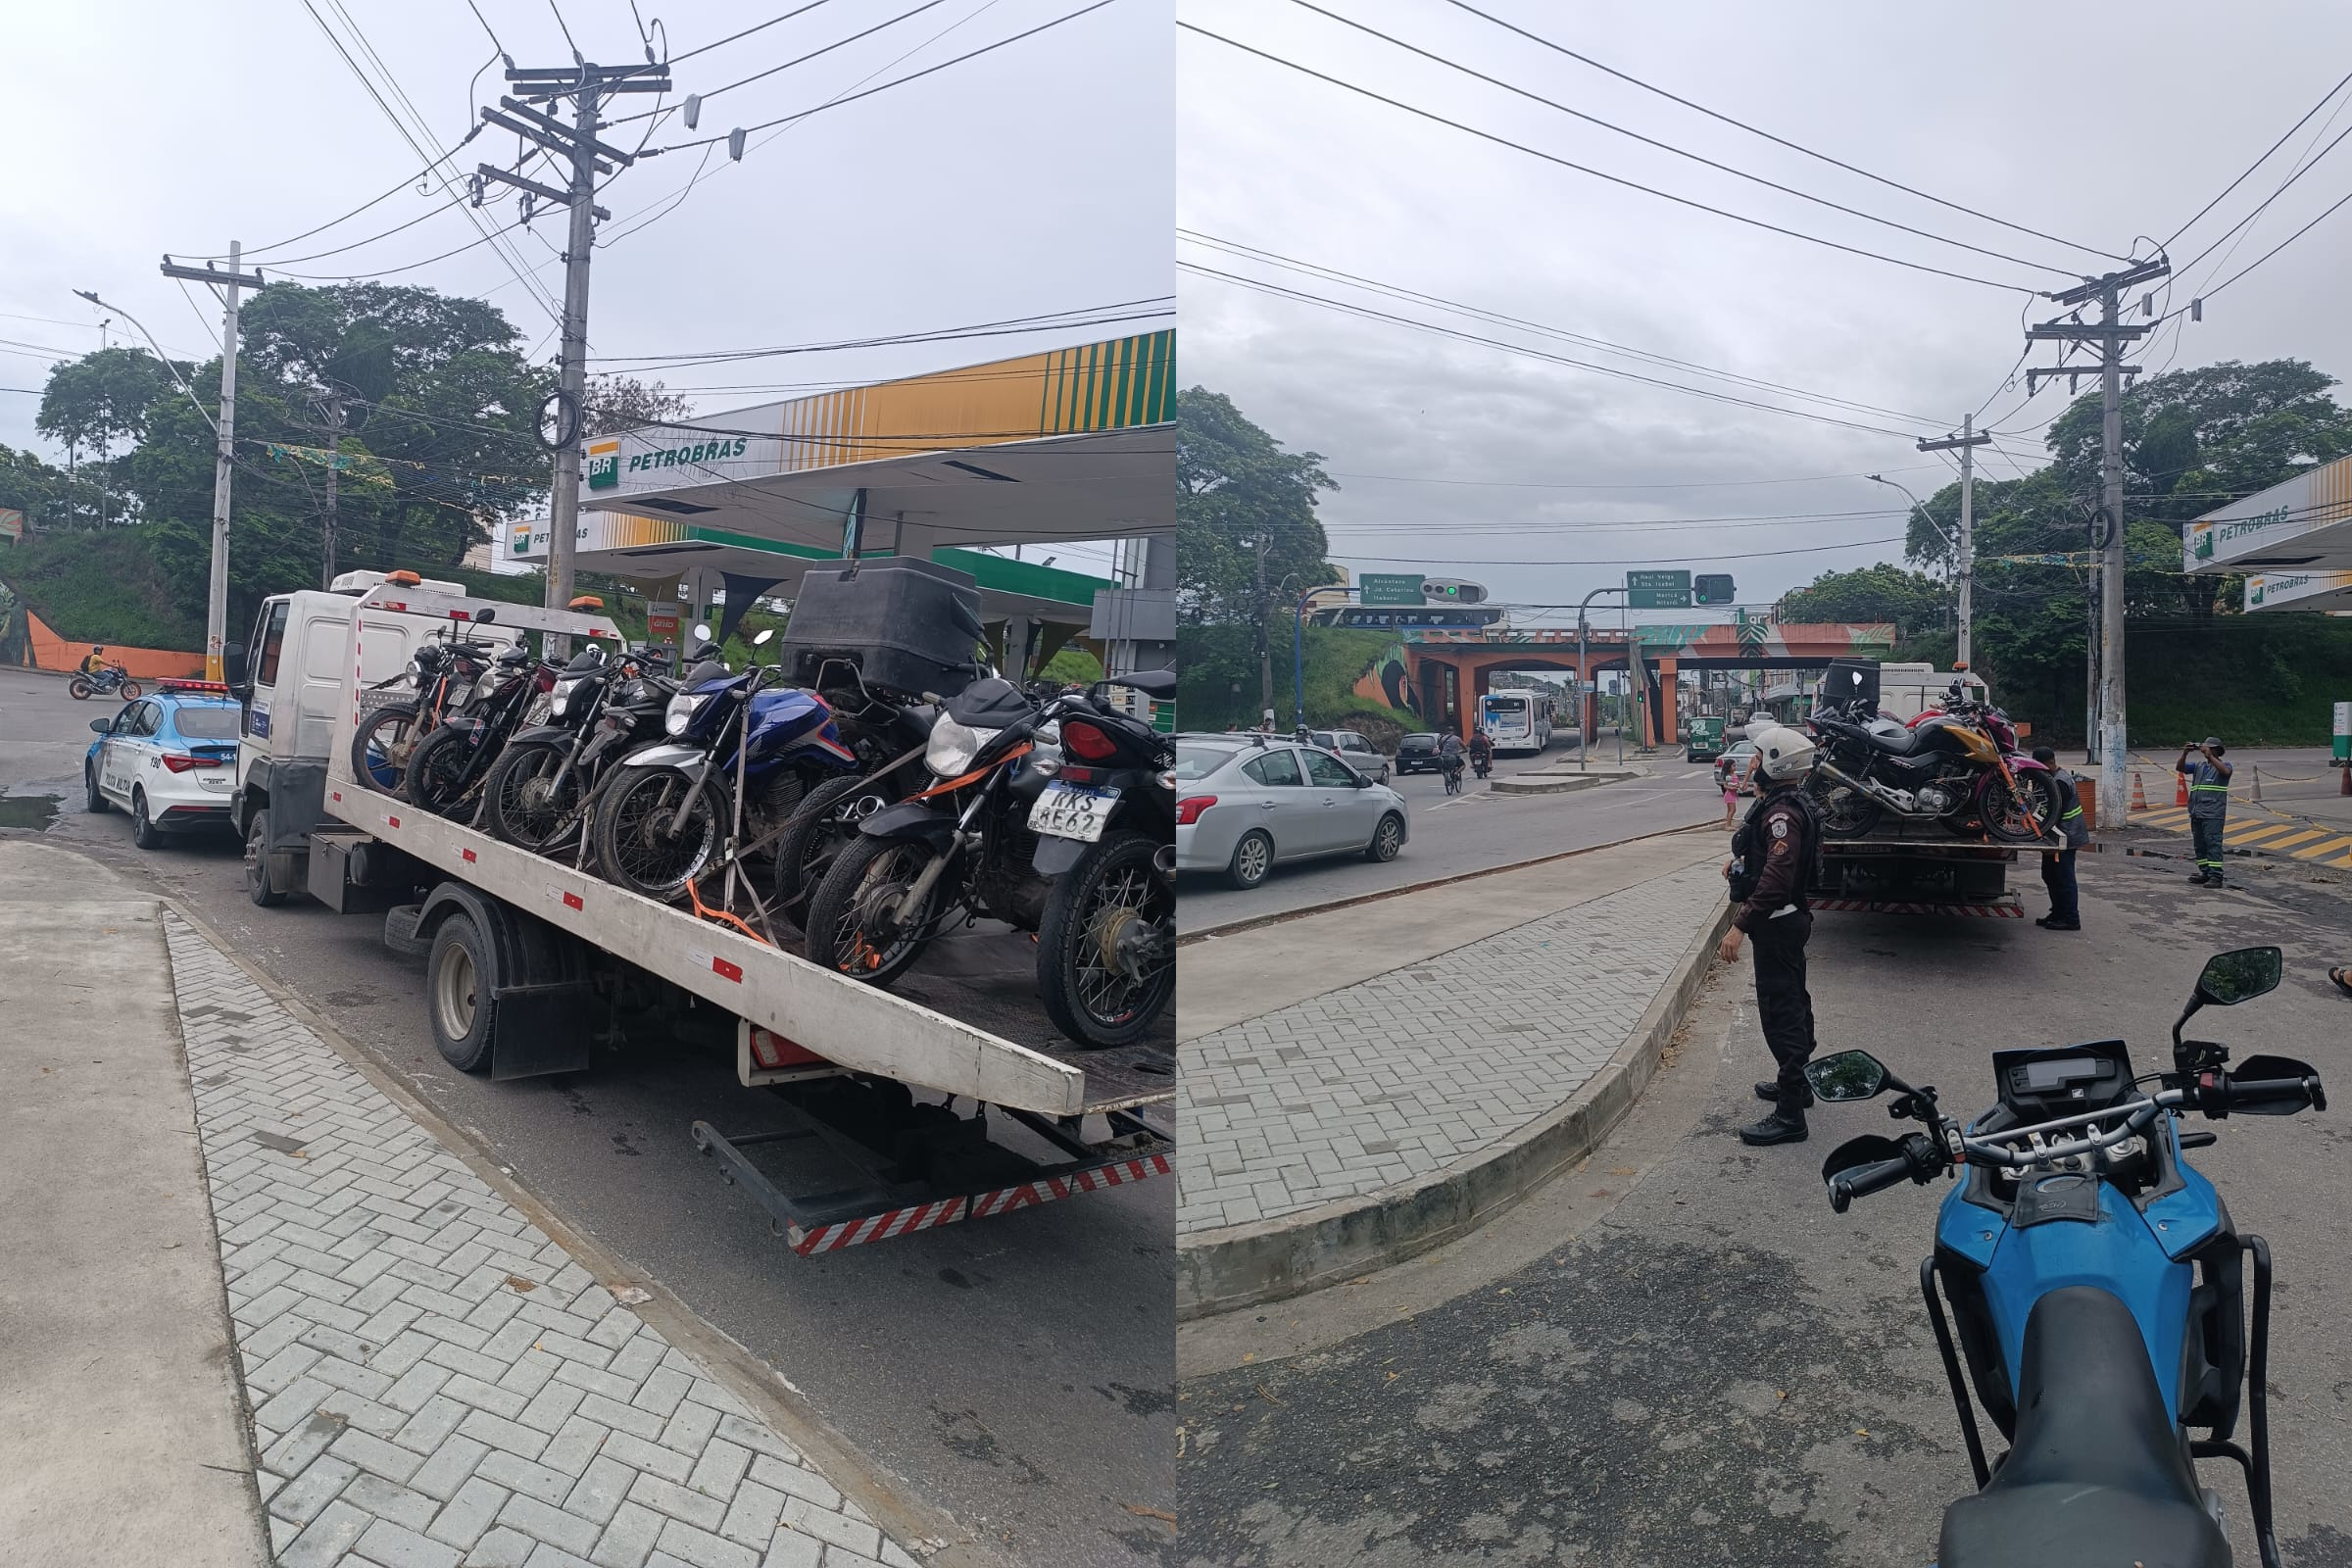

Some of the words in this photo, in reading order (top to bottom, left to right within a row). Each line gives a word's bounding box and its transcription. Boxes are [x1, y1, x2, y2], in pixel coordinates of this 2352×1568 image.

[591, 458, 612, 475] BR
[629, 437, 747, 472] PETROBRAS
[2195, 534, 2207, 549] BR
[2220, 505, 2288, 543] PETROBRAS
[2267, 574, 2309, 594] PETROBRAS
[150, 756, 162, 769] 190
[1051, 792, 1098, 812] RKS
